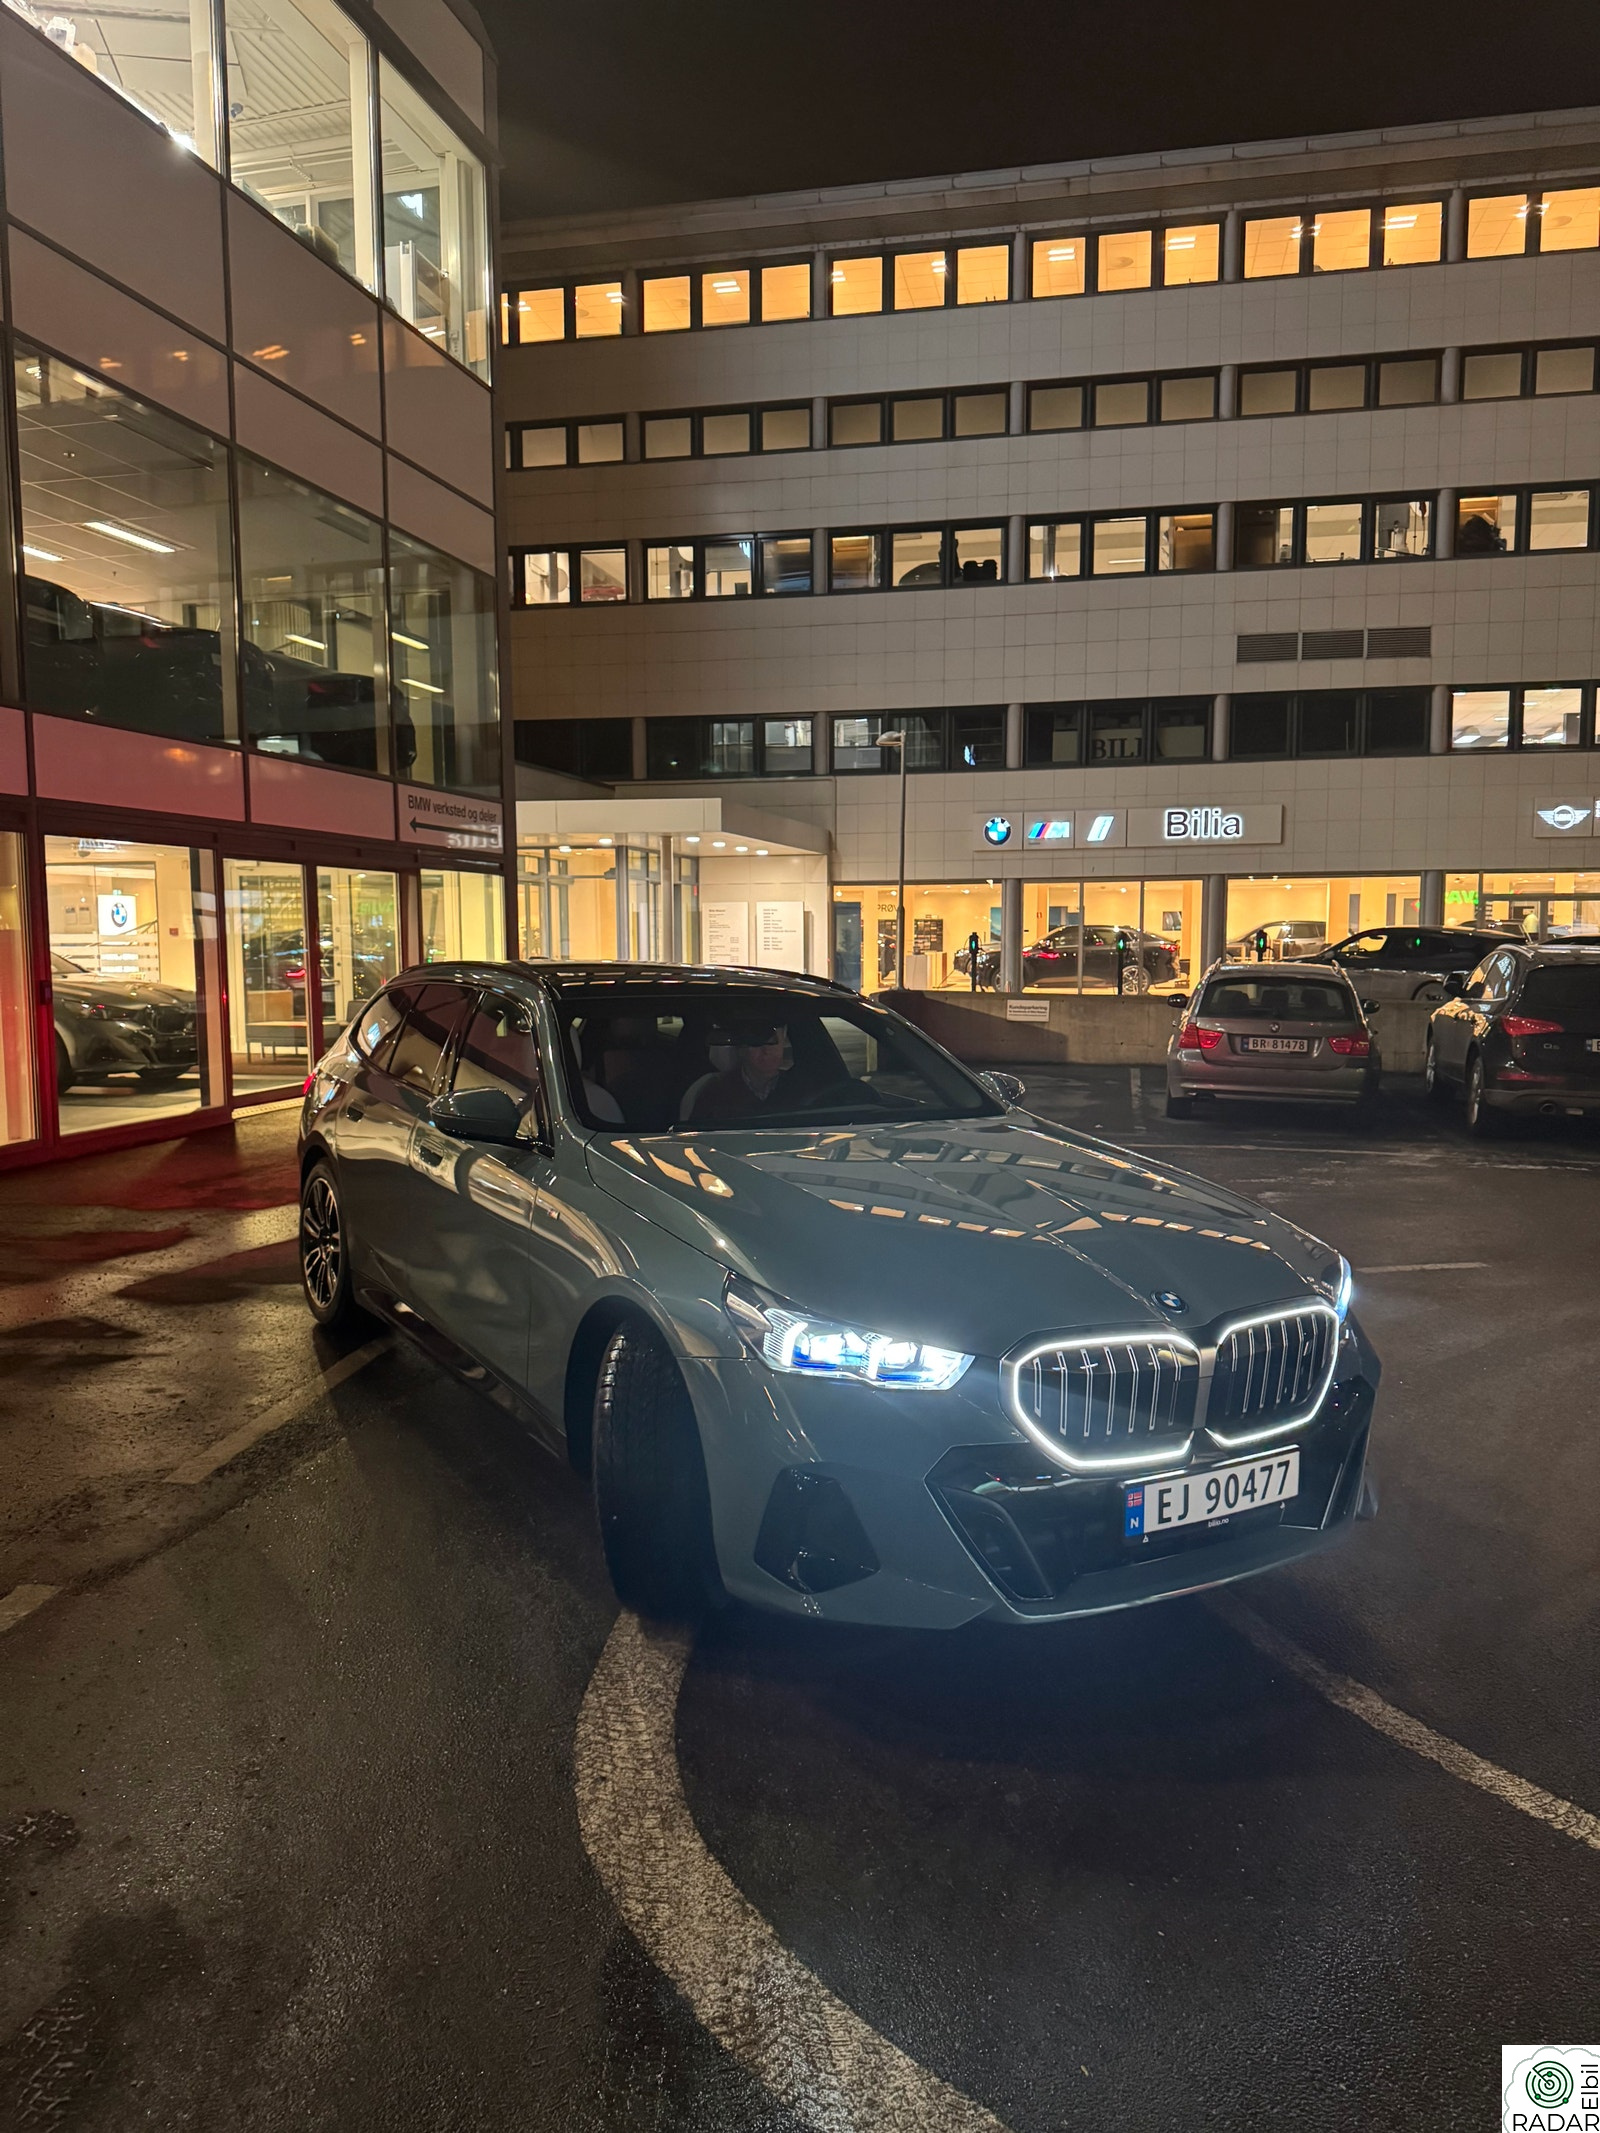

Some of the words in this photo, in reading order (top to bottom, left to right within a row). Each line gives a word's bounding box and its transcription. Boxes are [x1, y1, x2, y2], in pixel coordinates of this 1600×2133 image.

[408, 795, 431, 811] BMW
[433, 803, 466, 818] verksted
[468, 809, 477, 822] og
[480, 809, 497, 822] deler
[1165, 808, 1243, 838] Bilia
[1252, 1039, 1266, 1048] BR
[1272, 1040, 1305, 1050] 81478
[1130, 1517, 1139, 1529] N
[1157, 1484, 1190, 1525] EJ
[1205, 1460, 1290, 1515] 90477
